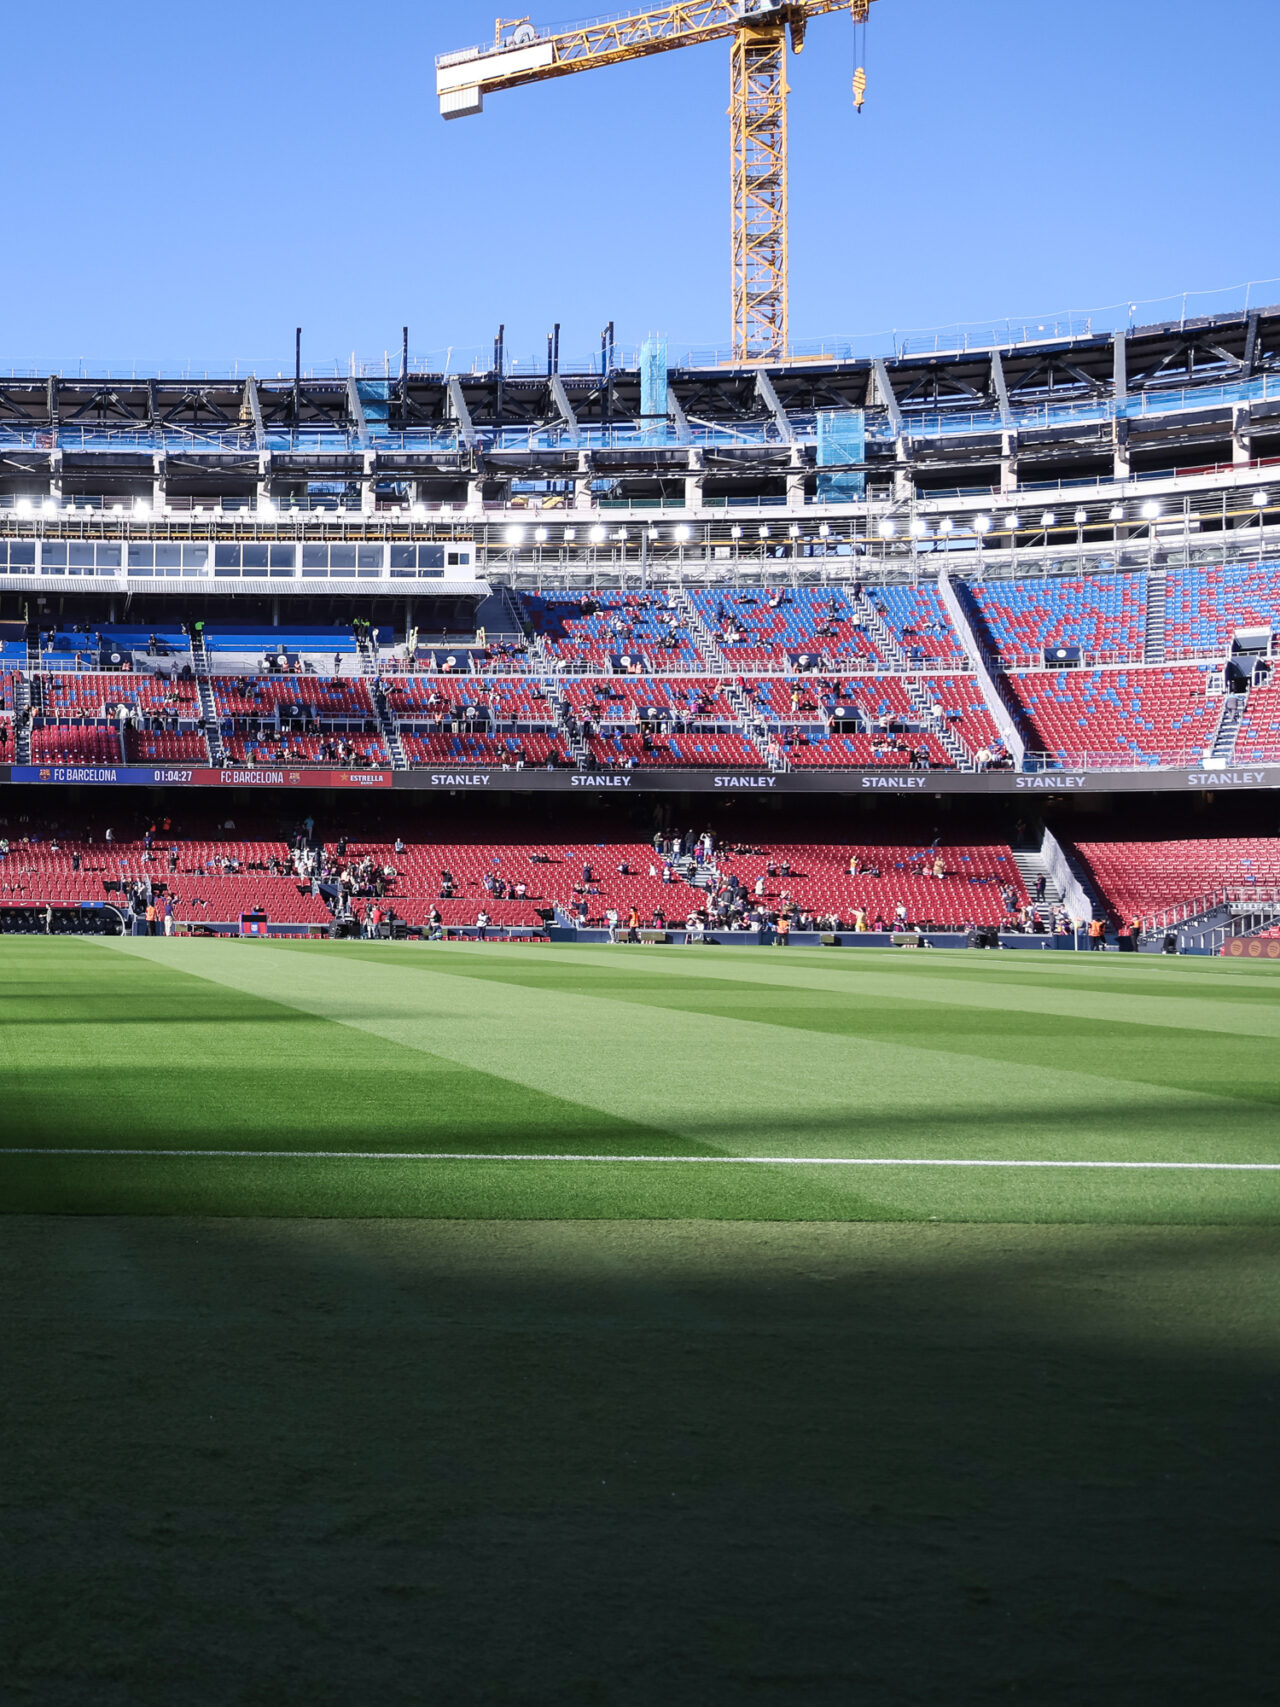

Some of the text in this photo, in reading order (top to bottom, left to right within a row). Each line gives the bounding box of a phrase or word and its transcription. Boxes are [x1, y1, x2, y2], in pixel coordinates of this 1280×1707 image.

[54, 768, 116, 781] FC BARCELONA
[154, 770, 192, 782] 01:04:27
[220, 771, 284, 784] FC BARCELONA
[431, 774, 490, 785] STANLEY
[1187, 771, 1265, 785] STANLEY
[571, 775, 631, 787] STANLEY
[714, 776, 776, 787] STANLEY
[861, 777, 926, 788] STANLEY
[1015, 776, 1086, 788] STANLEY
